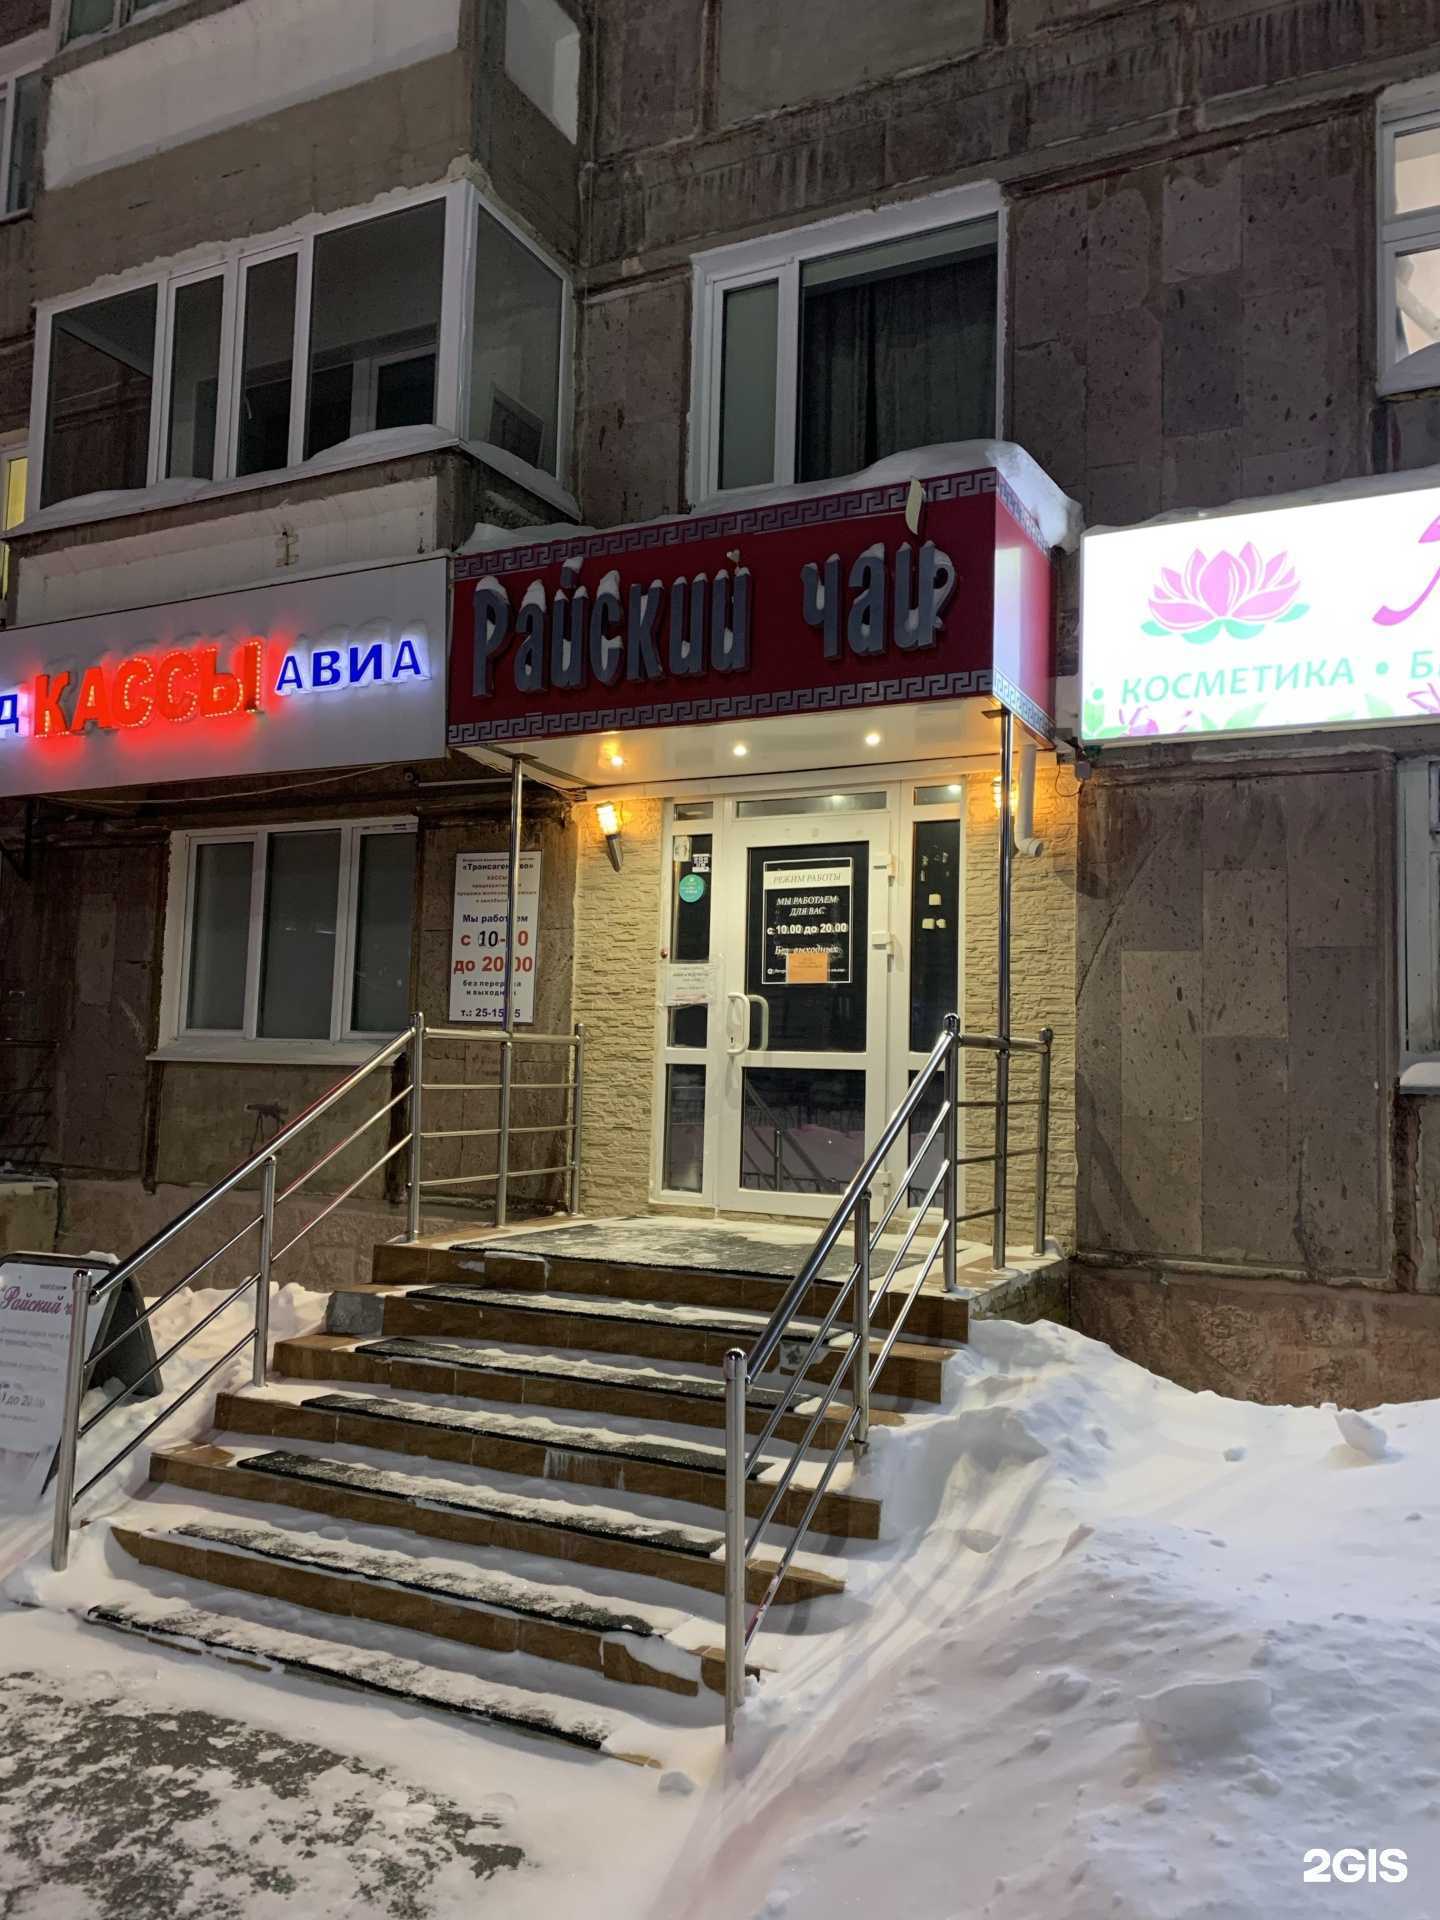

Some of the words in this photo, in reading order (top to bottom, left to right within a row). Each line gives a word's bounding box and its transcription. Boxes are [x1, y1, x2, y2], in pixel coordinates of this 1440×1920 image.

[470, 552, 752, 699] Райский
[1120, 656, 1356, 705] КОСМЕТИКА
[34, 638, 265, 738] КАССЫ
[276, 638, 422, 693] АВИА
[806, 872, 841, 883] РАБОТЫ
[775, 897, 792, 906] МЫ
[793, 895, 840, 905] РАБОТАЕМ
[462, 914, 479, 923] Мы
[788, 907, 808, 917] ДЛЯ
[808, 906, 827, 916] ВАС
[776, 924, 803, 935] 10.00
[803, 925, 819, 936] до
[819, 922, 848, 934] 20.00
[478, 930, 529, 947] 10-0
[453, 960, 476, 975] до
